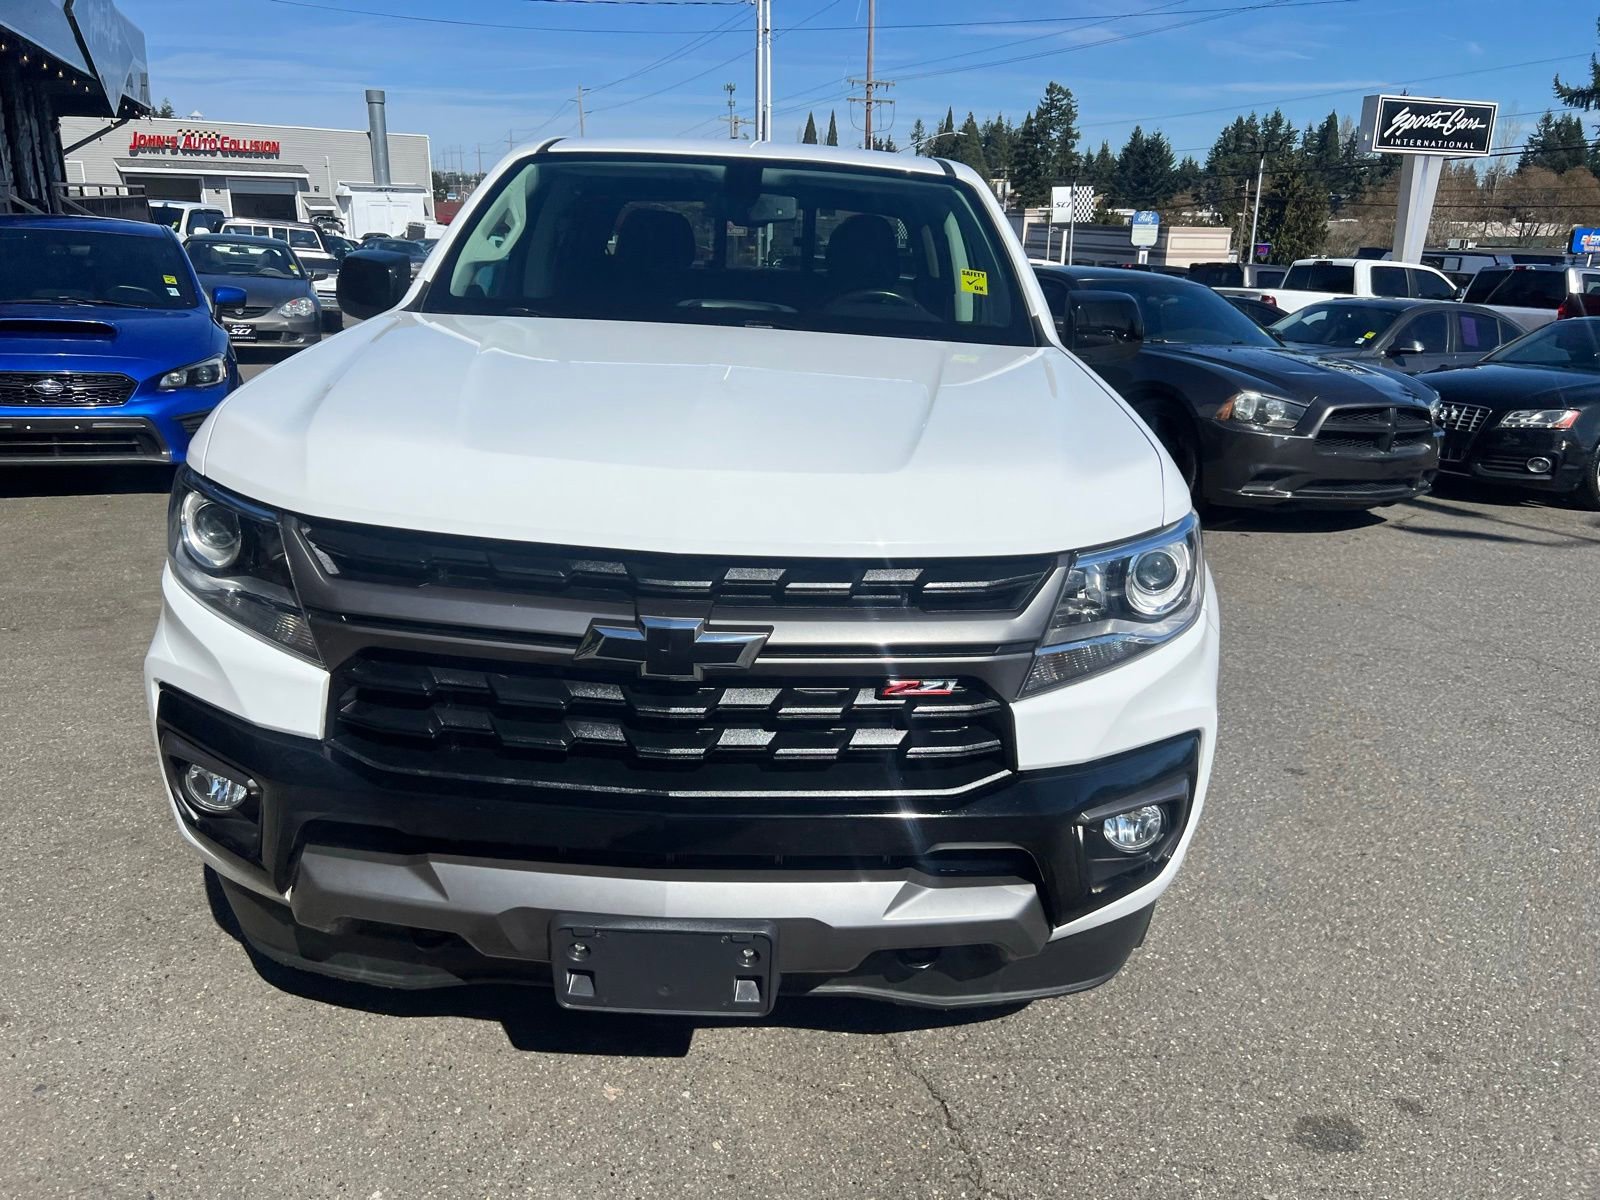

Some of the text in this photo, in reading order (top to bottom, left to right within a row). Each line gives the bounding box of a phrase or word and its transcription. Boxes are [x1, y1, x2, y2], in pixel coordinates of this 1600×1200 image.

[1383, 106, 1486, 138] Sports Cars
[182, 134, 217, 150] AUTO
[220, 136, 280, 153] COLLISION
[1390, 138, 1475, 149] INTERNATIONAL
[961, 270, 985, 278] SAFETY
